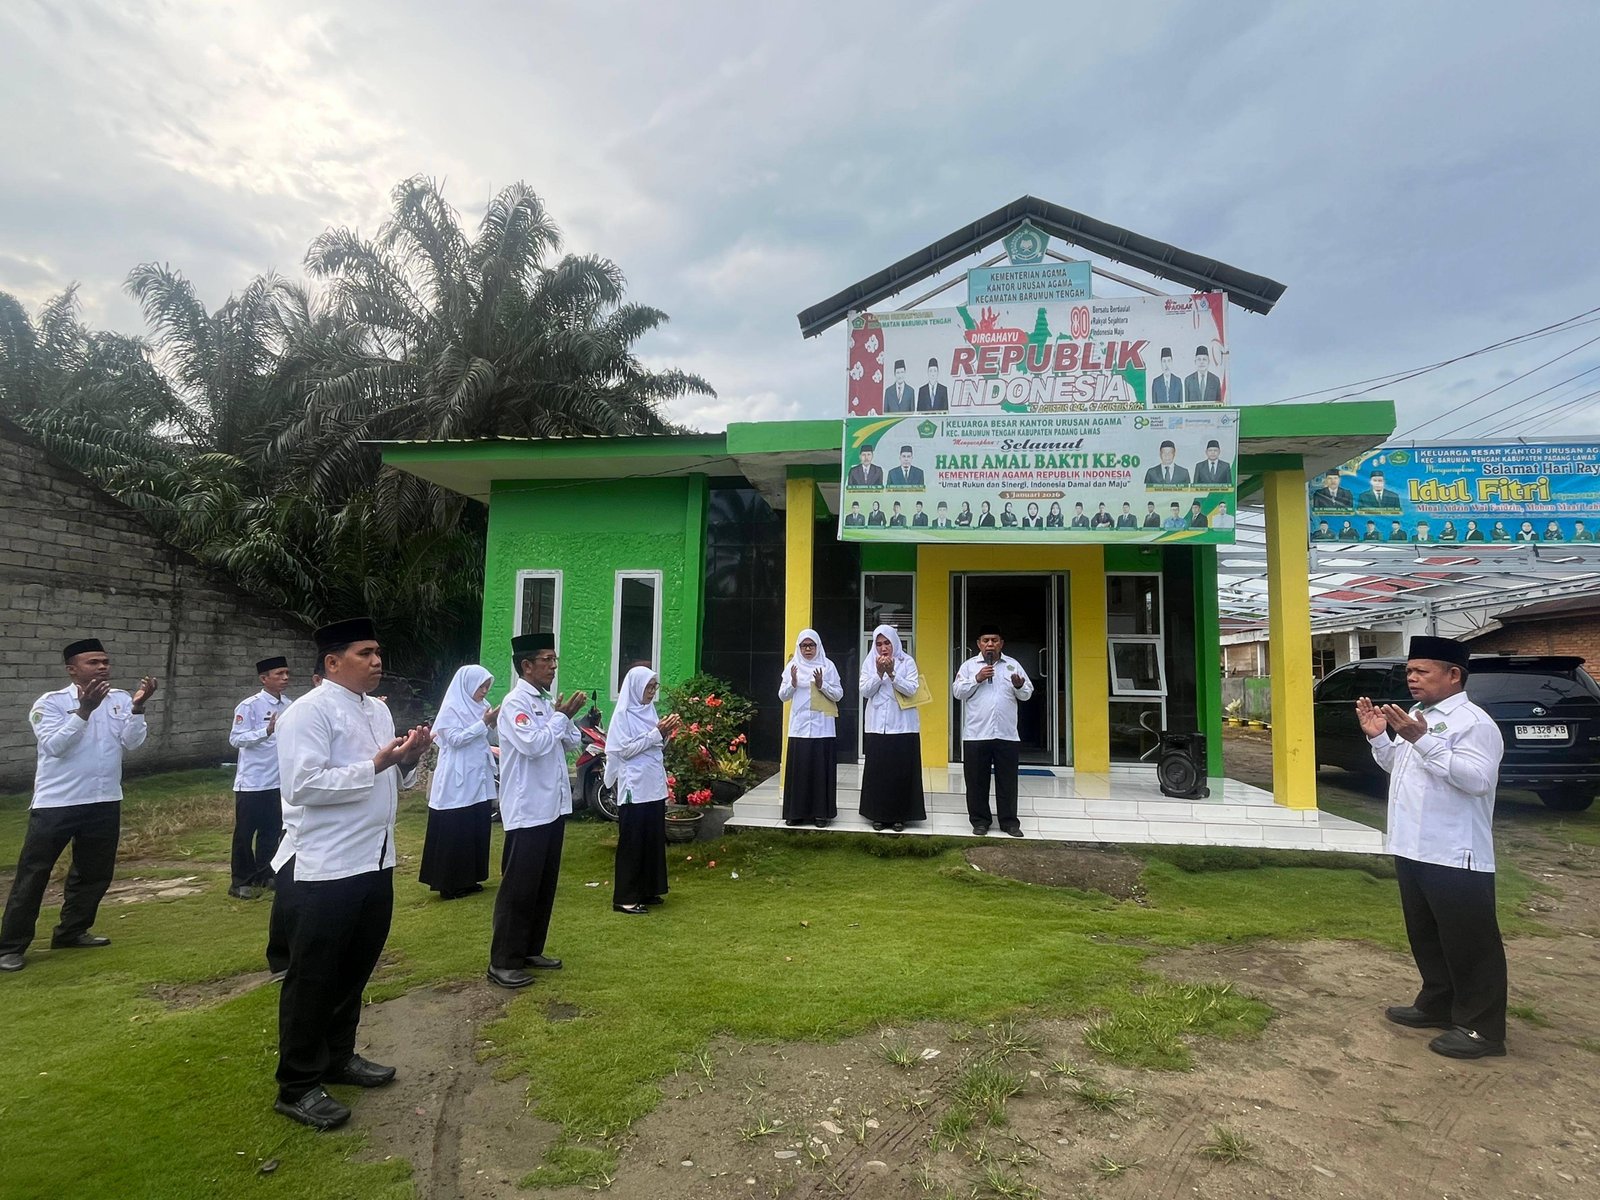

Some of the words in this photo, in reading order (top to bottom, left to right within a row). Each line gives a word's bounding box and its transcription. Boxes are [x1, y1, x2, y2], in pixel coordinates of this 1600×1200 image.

[990, 271, 1040, 281] KEMENTERIAN
[1042, 268, 1066, 278] AGAMA
[987, 282, 1015, 292] KANTOR
[1017, 280, 1046, 290] URUSAN
[1048, 279, 1072, 288] AGAMA
[976, 294, 1016, 304] KECAMATAN
[1020, 292, 1054, 302] BARUMUN
[1056, 289, 1084, 298] TENGAH
[1070, 306, 1090, 340] 80
[971, 332, 1018, 344] DIRGAHAYU
[951, 340, 1147, 376] REPUBLIK
[950, 374, 1130, 407] INDONESIA
[946, 419, 988, 428] KELUARGA
[990, 419, 1017, 428] BESAR
[1019, 418, 1053, 428] KANTOR
[1055, 418, 1090, 427] URUSAN
[1092, 418, 1122, 426] AGAMA
[961, 429, 990, 437] BARUMUN
[992, 428, 1016, 436] TENGAH
[1017, 428, 1052, 436] KABUPATEN
[1054, 428, 1078, 436] PADANG
[1080, 427, 1101, 436] LAWAS
[1000, 438, 1084, 451] Selamat
[936, 454, 978, 470] HARI
[981, 454, 1030, 470] AMAL
[1034, 454, 1088, 469] BAKTI
[1092, 454, 1140, 468] KE-80
[938, 472, 1000, 480] KEMENTERIAN
[1002, 471, 1034, 479] AGAMA
[1036, 470, 1080, 478] REPUBLIK
[1082, 470, 1131, 478] INDONESIA
[1483, 464, 1538, 475] Selamat
[1542, 463, 1572, 474] Hari
[1408, 478, 1472, 504] Idul
[1477, 476, 1550, 502] Fitri
[1416, 504, 1440, 512] Minal
[1526, 503, 1554, 512] Mohon
[1516, 726, 1528, 734] BB
[1532, 726, 1552, 734] 1328
